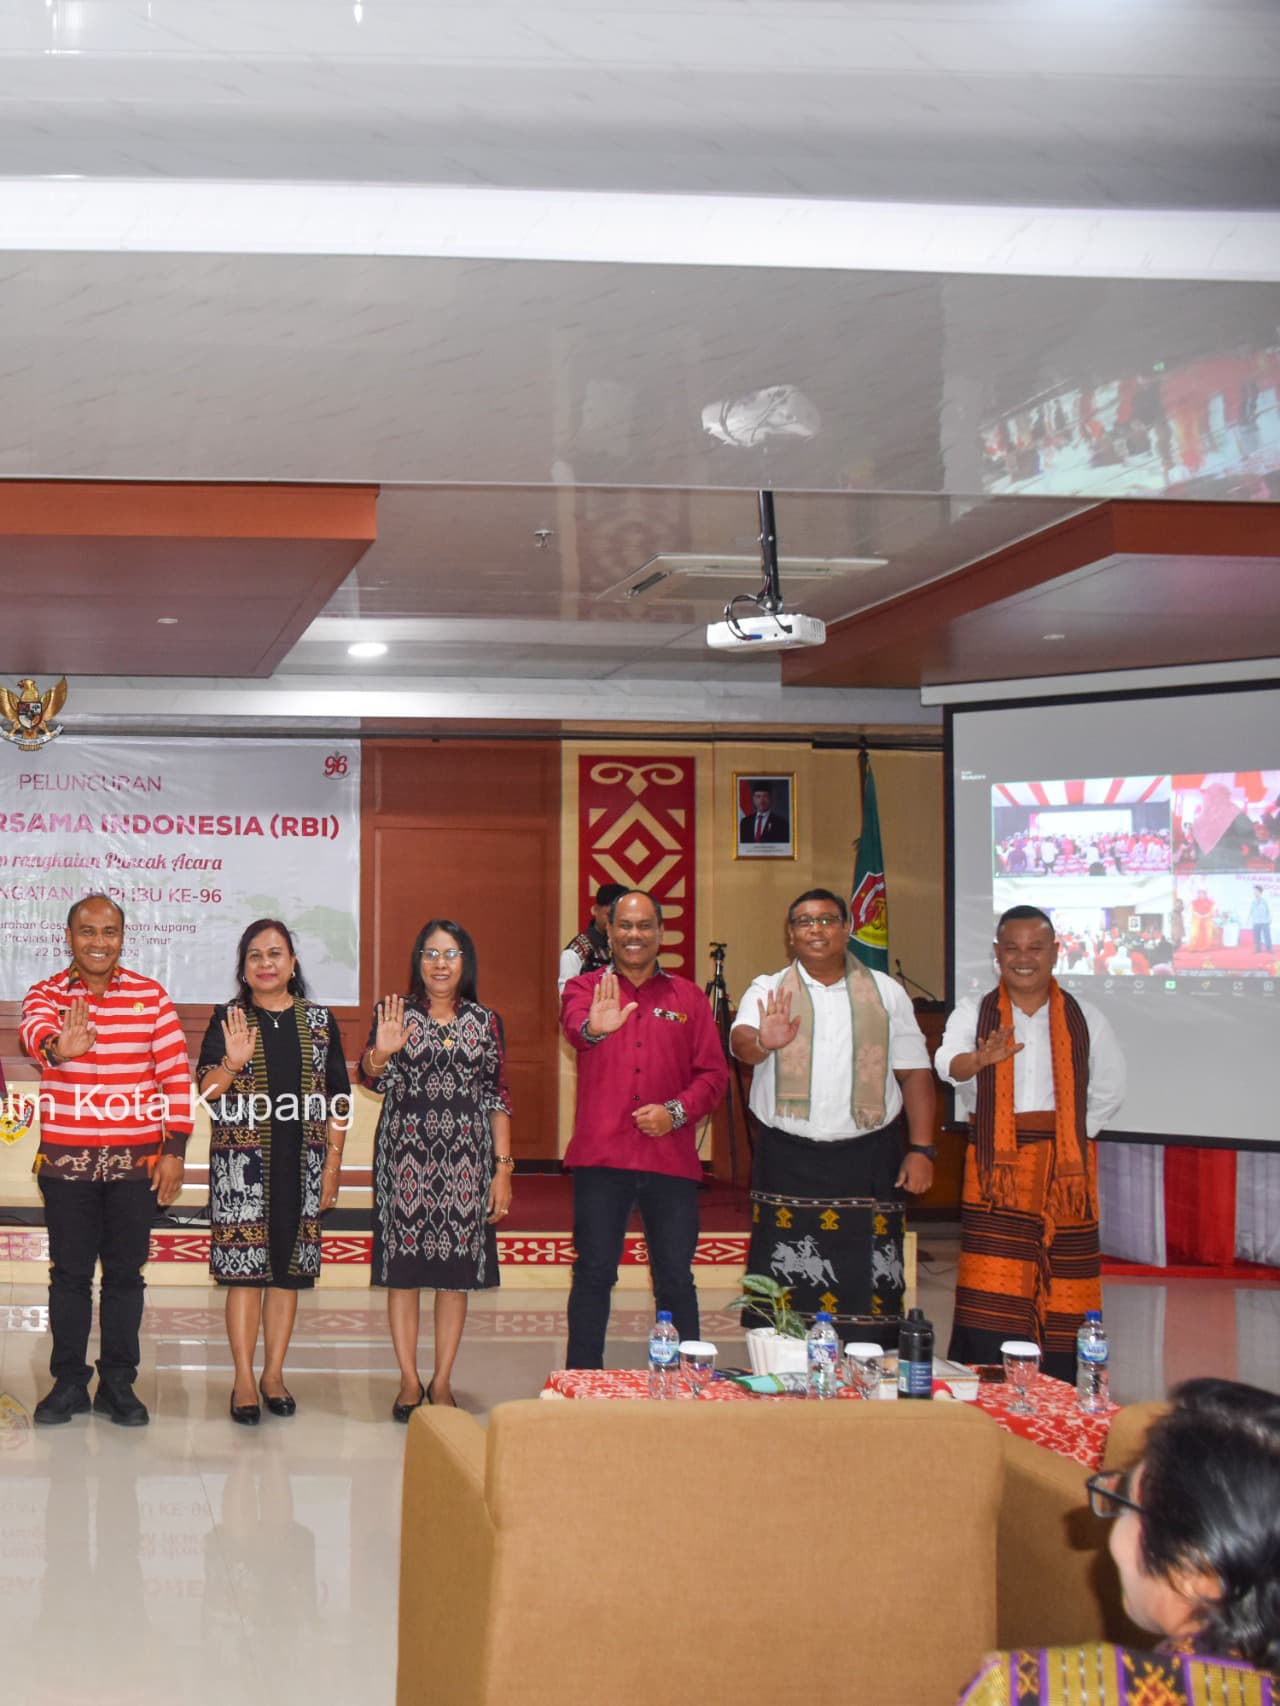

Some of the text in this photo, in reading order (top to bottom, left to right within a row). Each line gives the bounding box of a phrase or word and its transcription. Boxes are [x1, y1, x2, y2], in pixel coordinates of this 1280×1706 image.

[324, 755, 348, 777] 96
[19, 773, 162, 793] PELUNCURAN
[101, 814, 265, 836] INDONESIA
[270, 813, 340, 840] (RBI)
[11, 852, 101, 873] rangkaian
[104, 851, 167, 871] Puncak
[171, 852, 223, 872] Acara
[131, 887, 162, 903] IBU
[168, 888, 223, 904] KE-96
[153, 923, 197, 934] Kupang
[34, 947, 49, 958] 22
